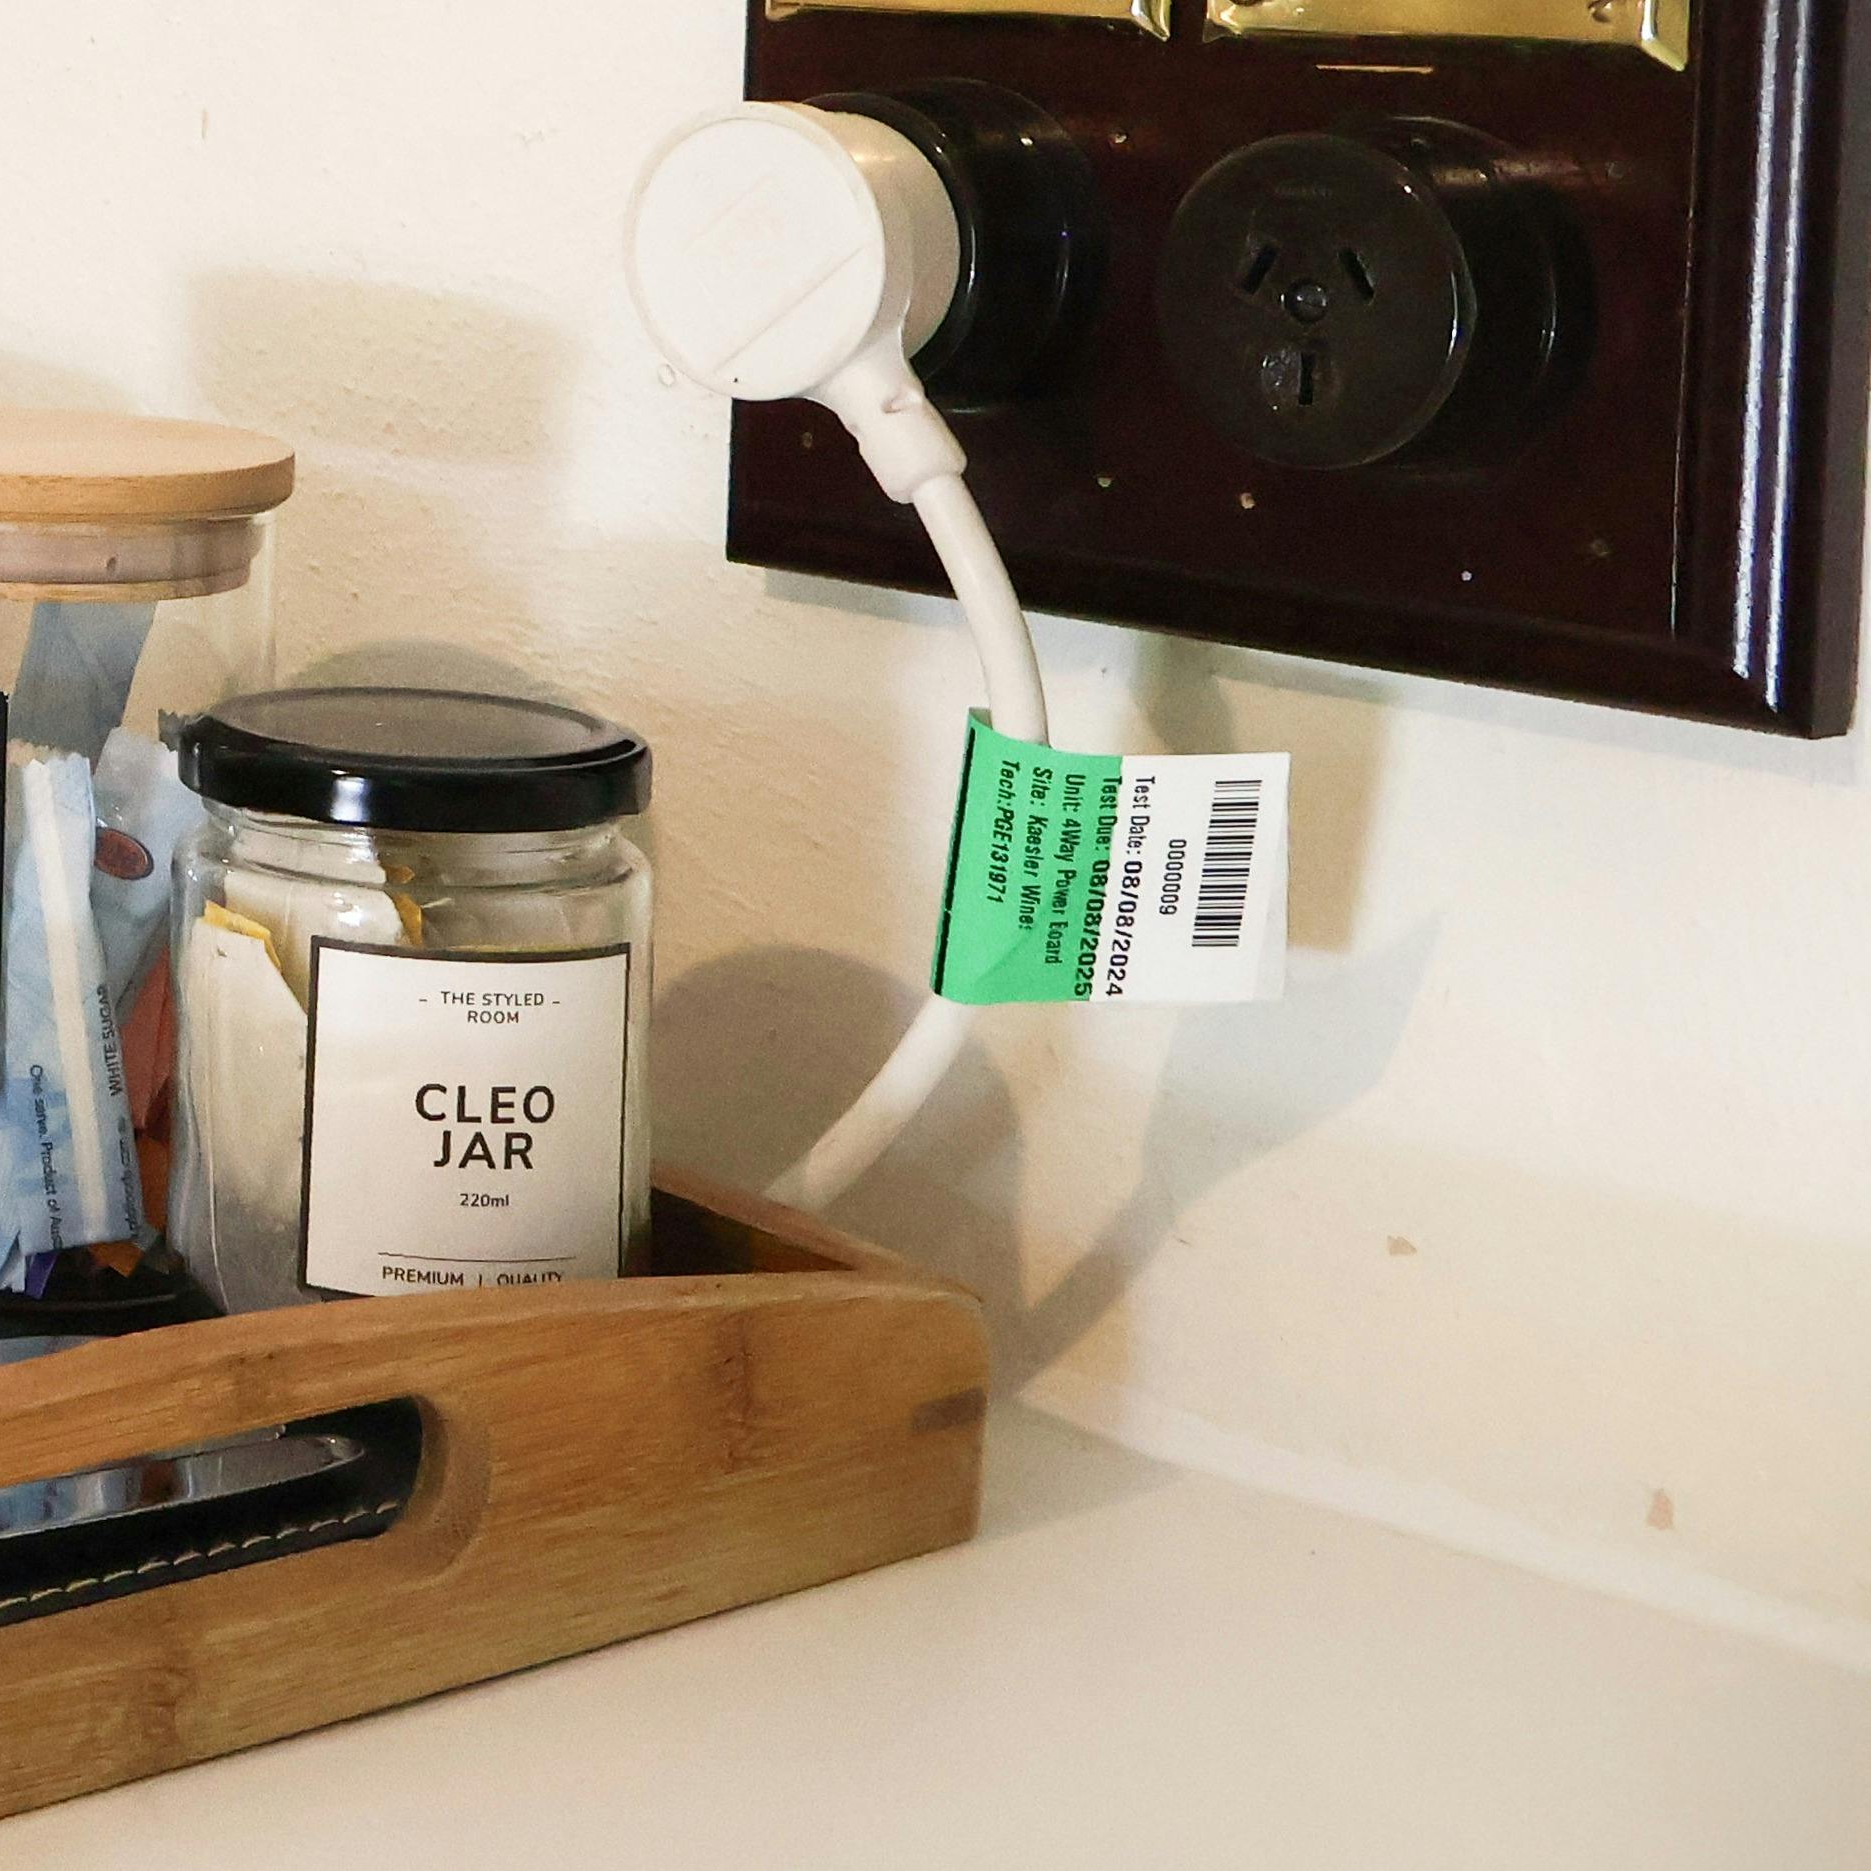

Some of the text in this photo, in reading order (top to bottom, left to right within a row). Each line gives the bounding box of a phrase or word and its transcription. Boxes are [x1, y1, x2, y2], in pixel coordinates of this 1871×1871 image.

[1030, 766, 1054, 805] Site:
[1063, 773, 1086, 814] Unit:
[1023, 814, 1049, 878] Kaesler
[1054, 819, 1082, 863] 4Way
[1049, 869, 1077, 916] Power
[1074, 775, 1123, 997] Test Due: 08/08/2025
[1105, 776, 1155, 997] Test Date: 08/08/2024
[1159, 839, 1187, 916] 0000009
[441, 990, 545, 1007] THE STYLED
[467, 1010, 520, 1025] ROOM
[102, 1044, 124, 1096] WHITE
[415, 1083, 555, 1125] CLEO
[40, 1141, 58, 1196] Product
[433, 1130, 534, 1170] JAR
[459, 1193, 510, 1208] 220ml
[382, 1265, 464, 1287] PREMIUM
